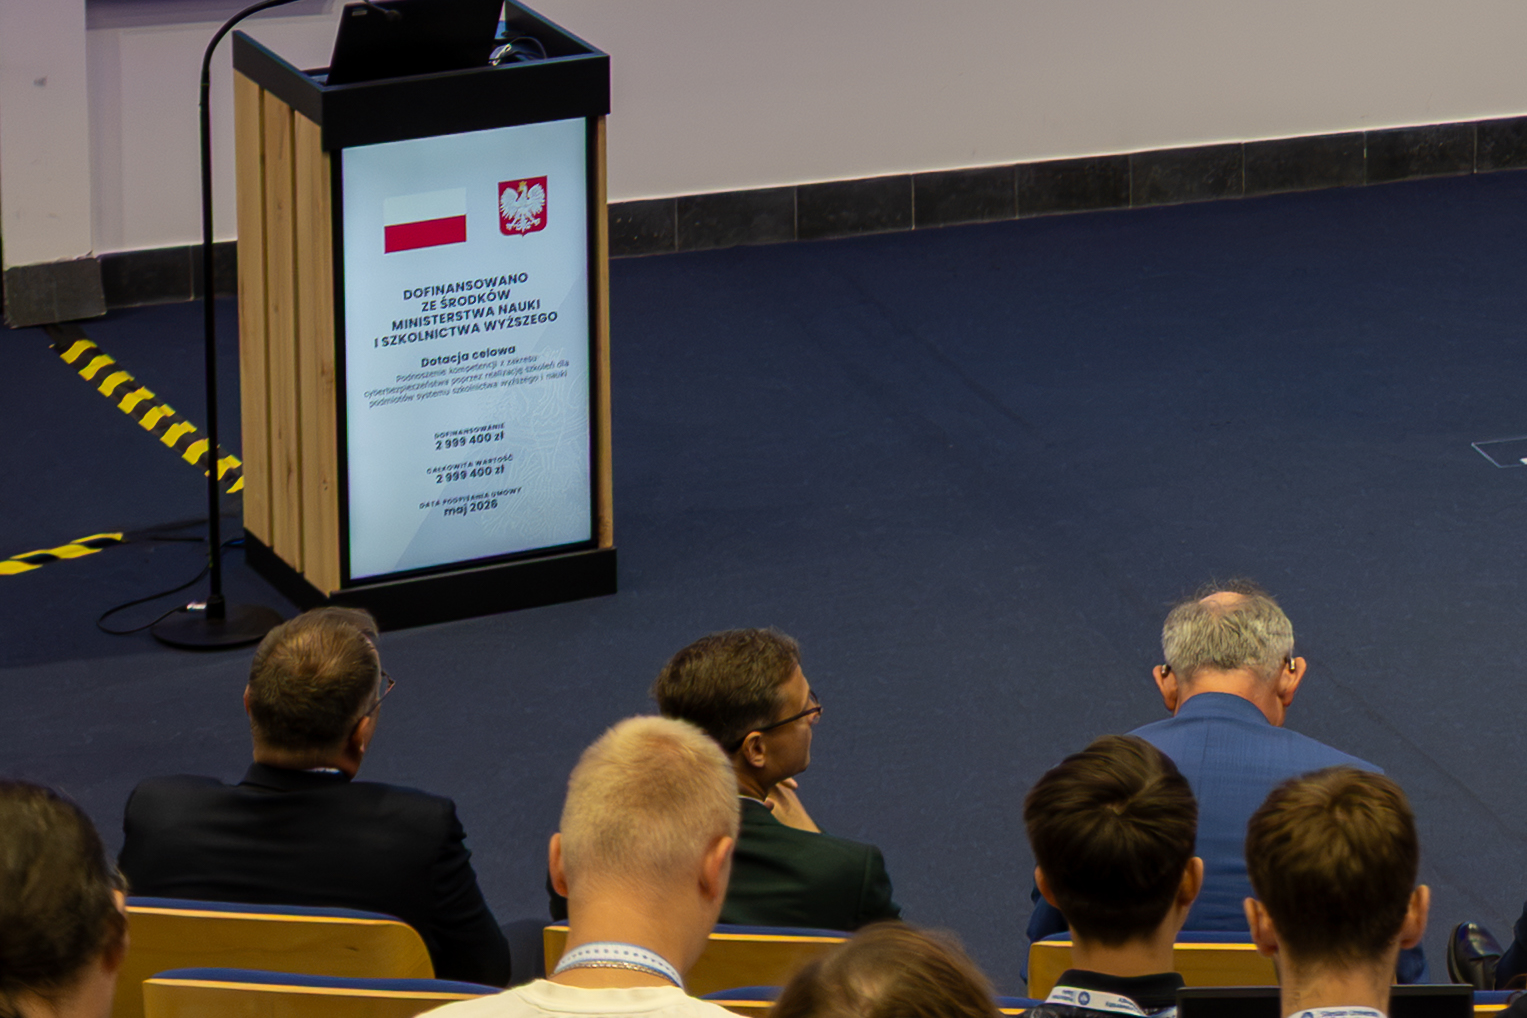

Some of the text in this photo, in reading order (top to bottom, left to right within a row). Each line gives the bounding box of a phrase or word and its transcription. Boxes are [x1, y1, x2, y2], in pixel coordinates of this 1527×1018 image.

[403, 272, 529, 301] DOFINANSOWANO
[421, 289, 511, 313] ZE ŚRODKÓW
[392, 298, 541, 332] MINISTERSTWA NAUKI
[374, 311, 558, 349] I SZKOLNICTWA WYŻSZEGO
[421, 345, 516, 368] Dotacja celowa
[435, 440, 442, 451] 2
[469, 432, 492, 445] 400
[436, 474, 443, 484] 2
[469, 466, 492, 478] 400
[444, 503, 467, 516] maj
